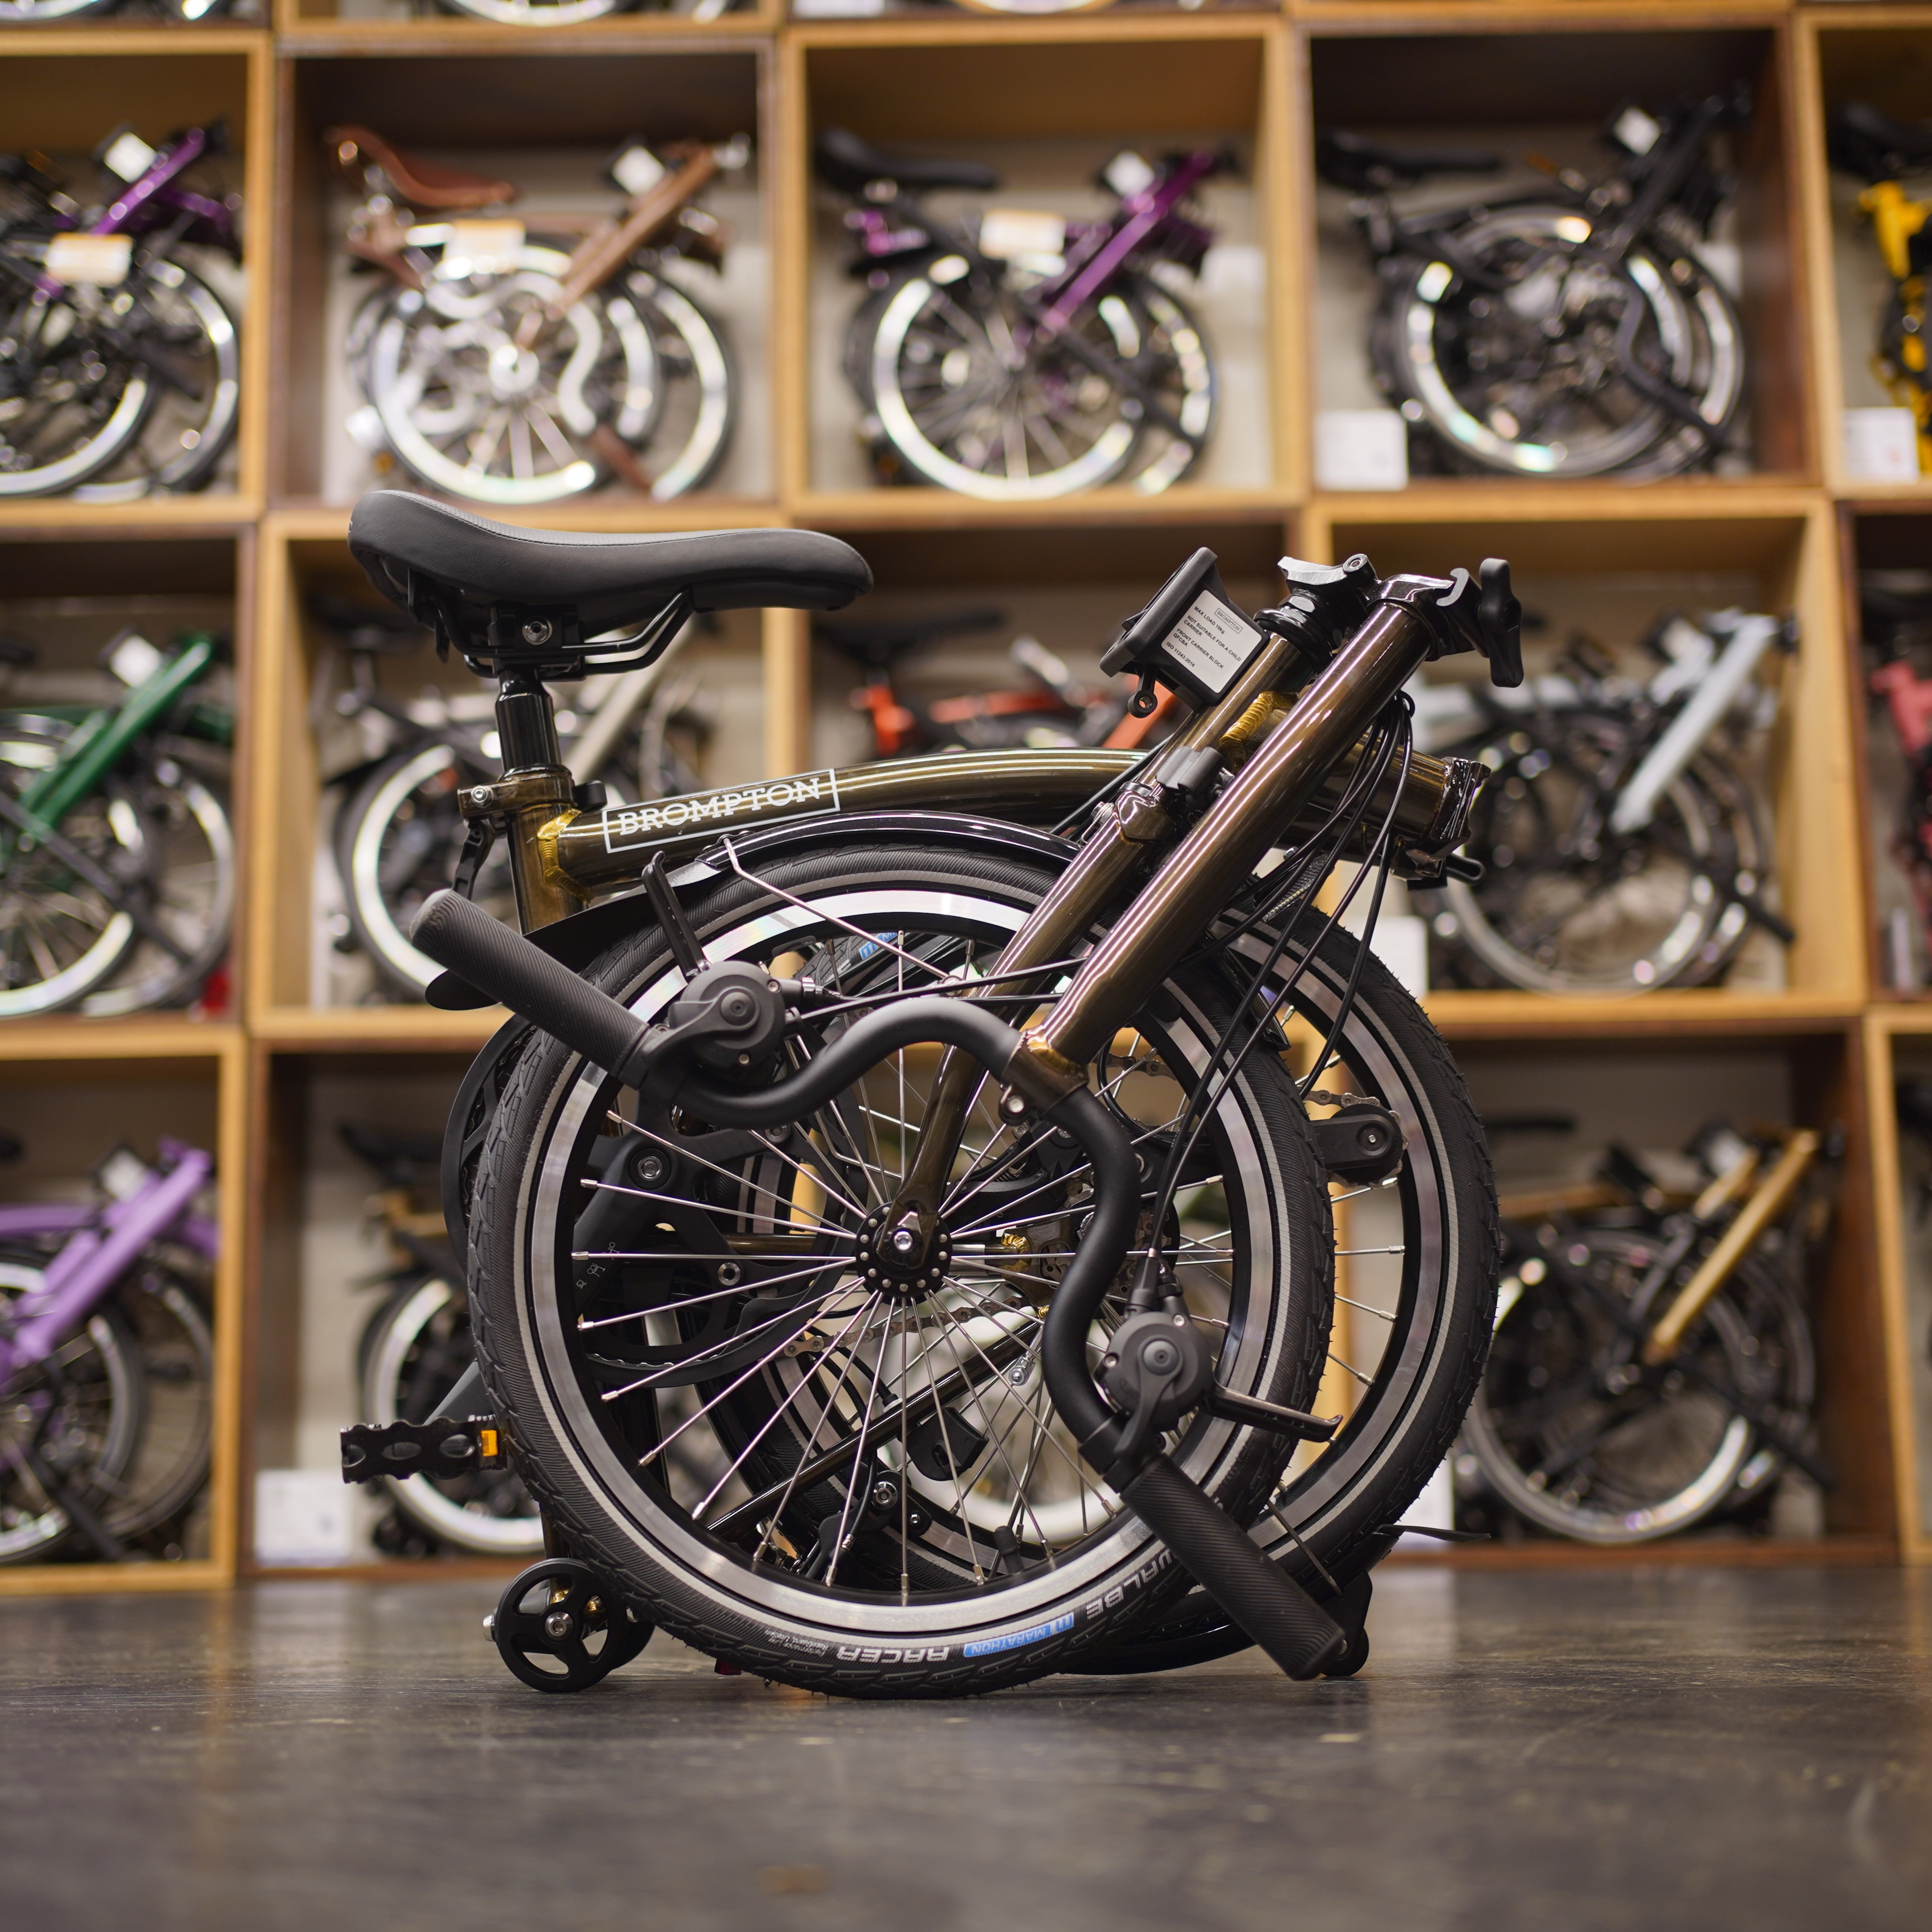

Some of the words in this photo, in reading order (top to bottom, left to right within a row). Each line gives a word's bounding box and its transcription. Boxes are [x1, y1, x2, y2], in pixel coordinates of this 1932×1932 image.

[1184, 620, 1202, 636] CARRIER
[1194, 606, 1204, 616] MAX
[1204, 614, 1216, 625] LOAD
[1216, 625, 1225, 634] 10kg
[1217, 611, 1240, 631] BROMPTON
[1174, 633, 1188, 646] QFCBA
[1177, 628, 1191, 641] FRONT
[1191, 641, 1209, 657] CARRIER
[1209, 655, 1224, 669] BLOCK
[1187, 615, 1197, 624] NOT
[1196, 623, 1216, 641] SUITABLE
[1216, 639, 1225, 648] FOR
[1228, 650, 1241, 661] CHILD
[1174, 649, 1195, 667] 11243:2016
[618, 777, 820, 836] BROMPTON
[1086, 1549, 1173, 1620] WALBE
[972, 1626, 1046, 1654] MARATHON
[836, 1646, 949, 1663] RACER
